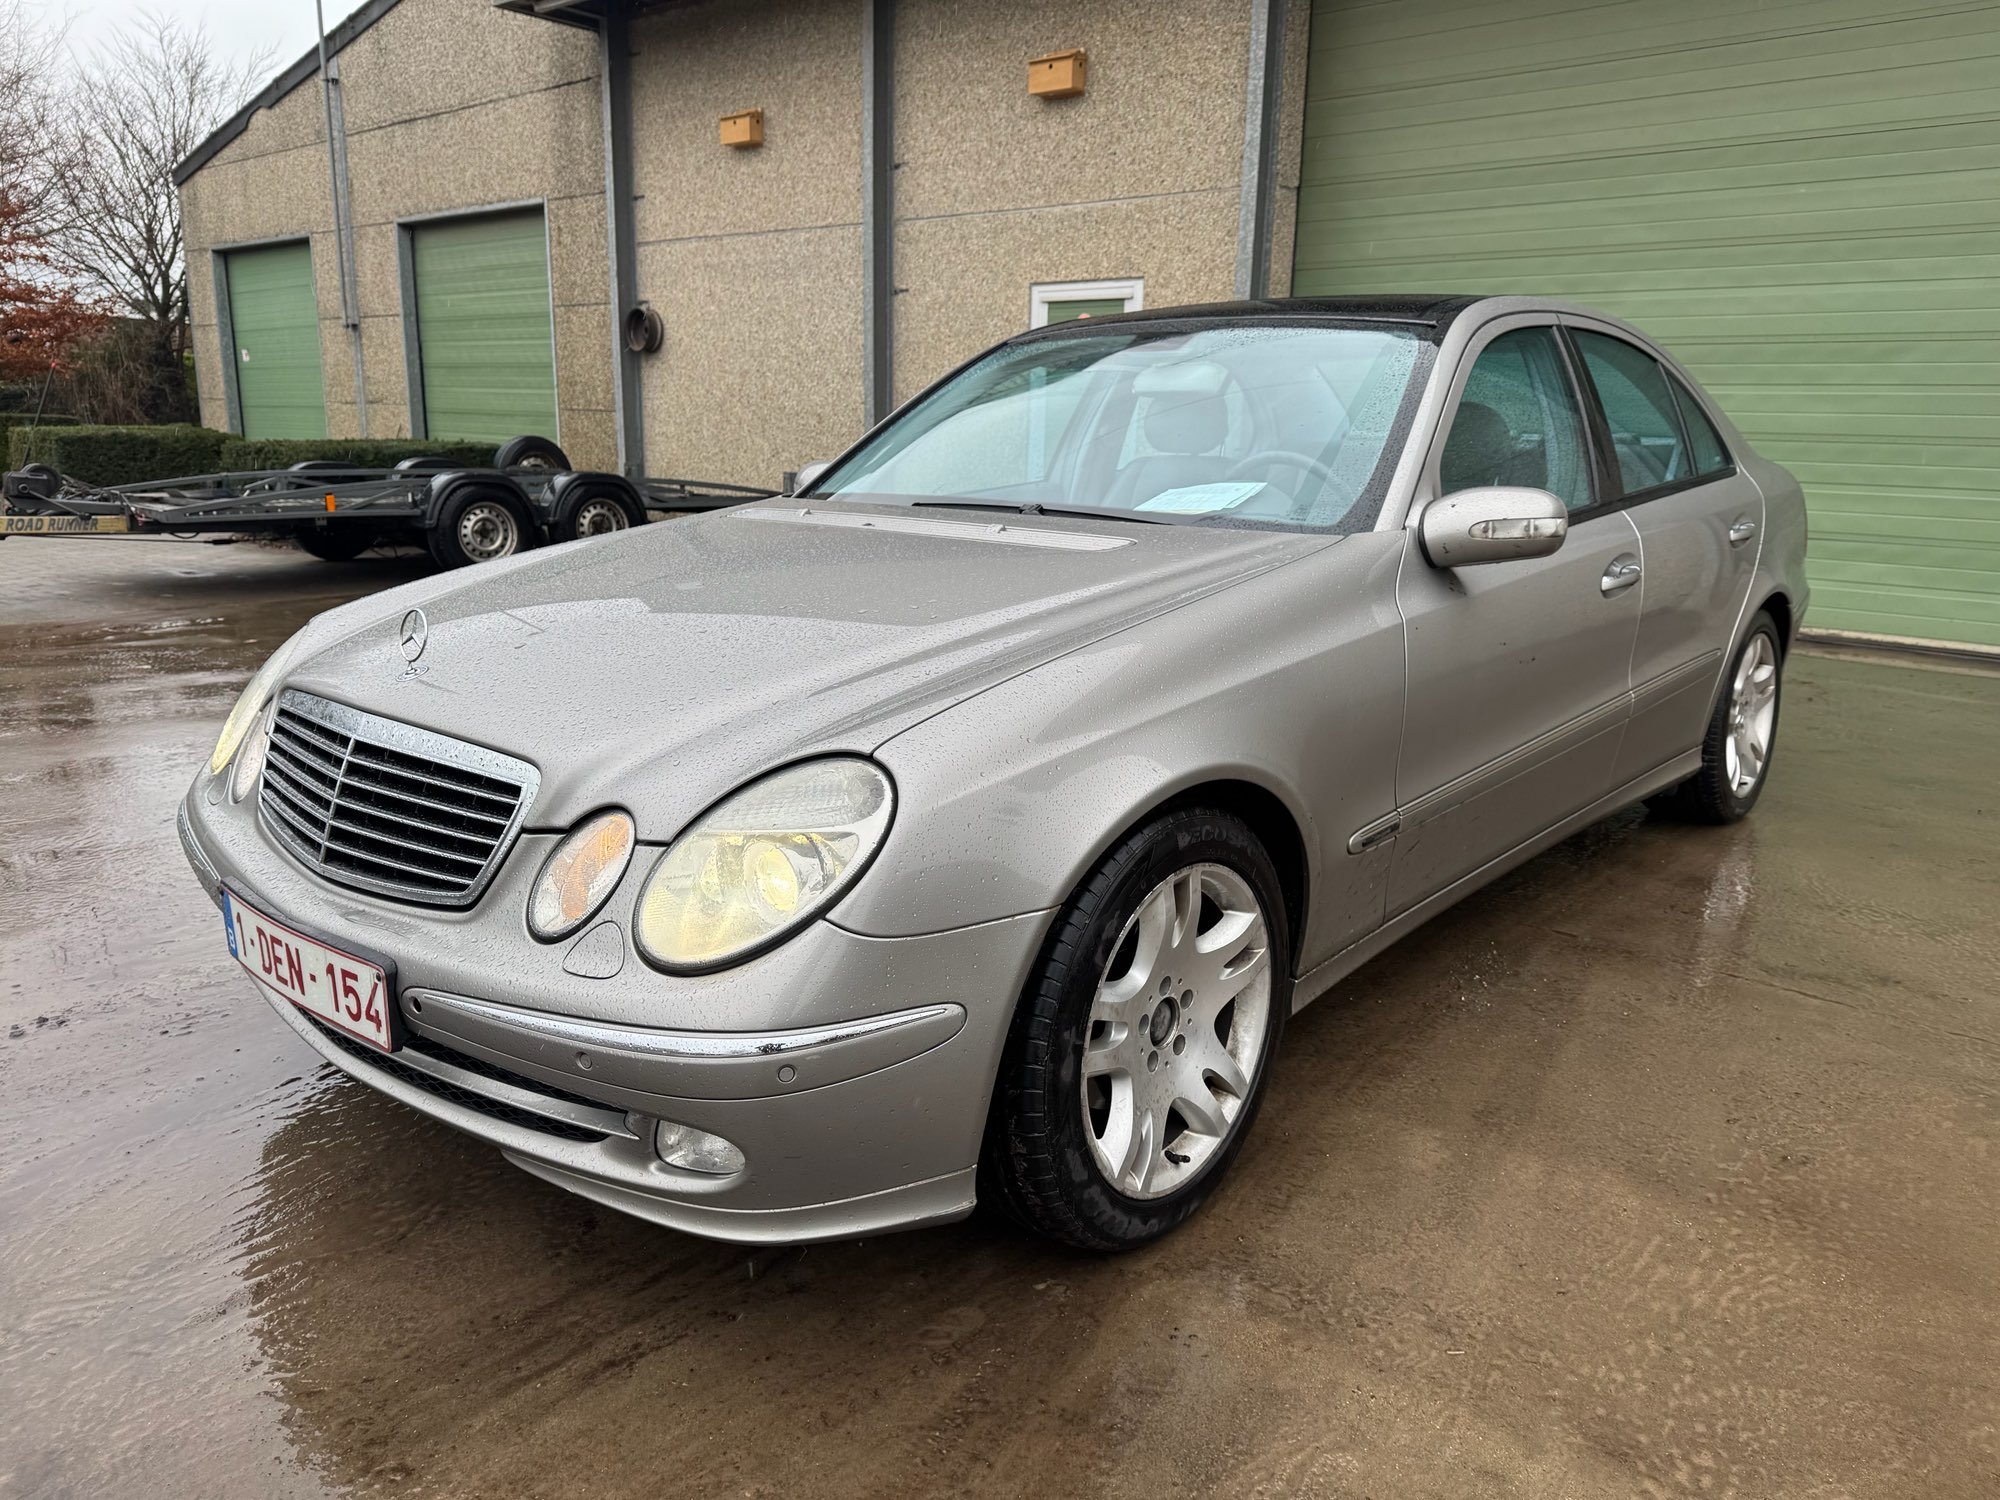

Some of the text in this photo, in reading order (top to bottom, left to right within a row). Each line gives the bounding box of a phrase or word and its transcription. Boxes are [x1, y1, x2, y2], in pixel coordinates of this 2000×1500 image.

[6, 517, 98, 532] ROAD RUNNER
[227, 927, 236, 950] B
[236, 911, 382, 1033] 1-DEN-154
